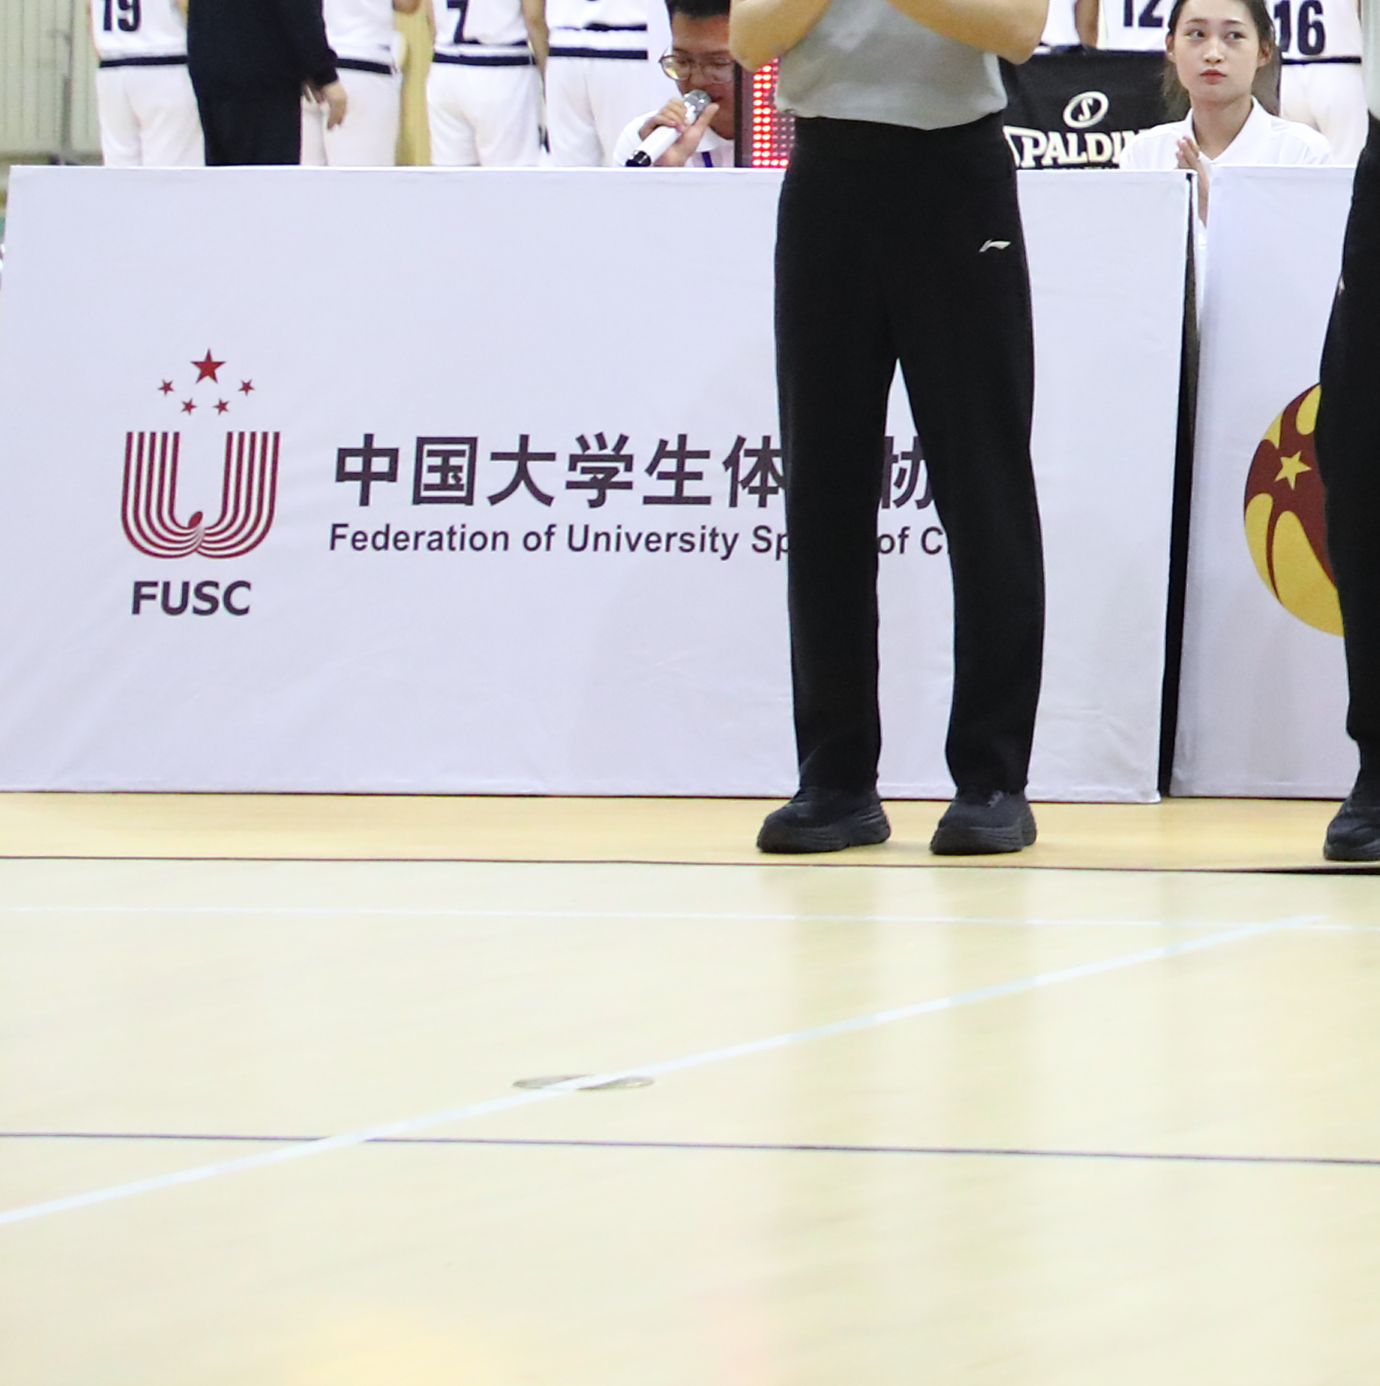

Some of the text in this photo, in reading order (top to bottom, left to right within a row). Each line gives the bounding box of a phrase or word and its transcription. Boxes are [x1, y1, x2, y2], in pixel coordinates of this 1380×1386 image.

[1274, 0, 1326, 56] 16
[1003, 125, 1148, 168] PALDI
[335, 432, 933, 509] 中国大学生体协
[329, 523, 509, 552] Federation
[522, 523, 557, 552] of
[567, 523, 740, 561] University
[877, 526, 911, 555] of
[131, 580, 251, 616] FUSC
